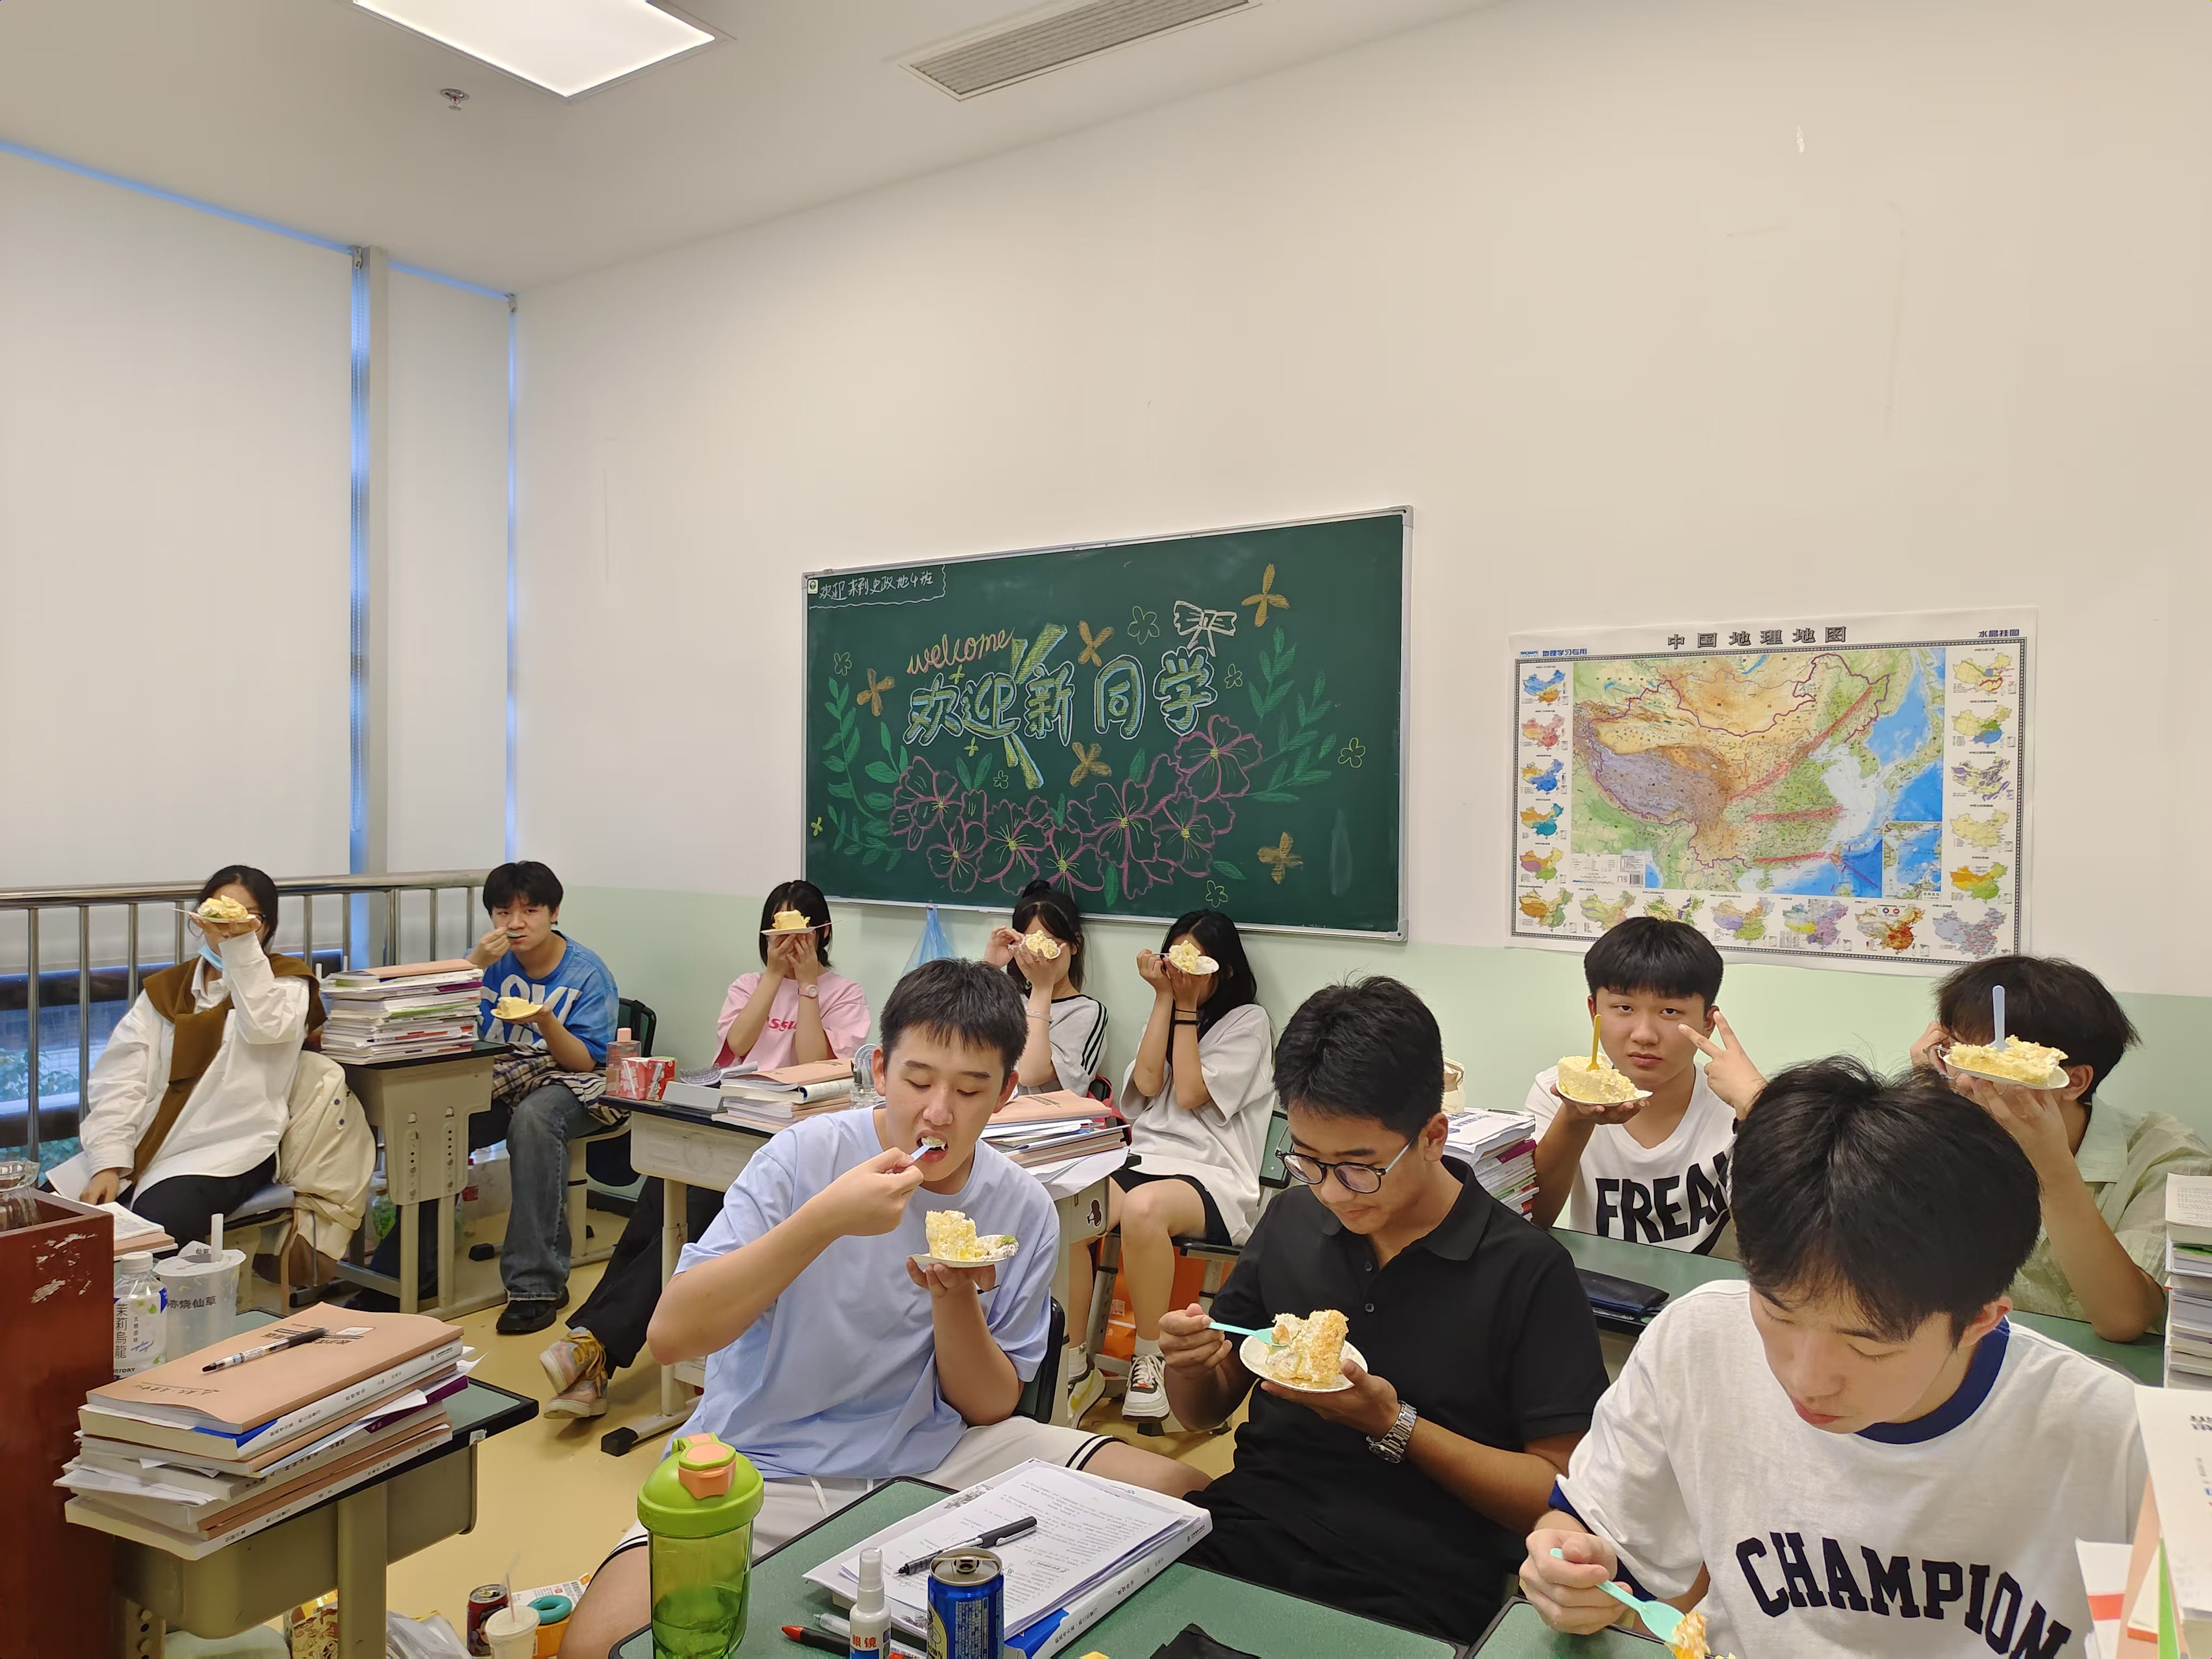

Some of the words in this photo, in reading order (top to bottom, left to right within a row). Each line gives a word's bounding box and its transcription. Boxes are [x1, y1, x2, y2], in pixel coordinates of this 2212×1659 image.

[906, 627, 1015, 674] welcome
[1542, 648, 1587, 657] 地理学习专用
[1668, 626, 1847, 650] 中国地理地图
[902, 647, 1218, 747] 欢迎新同学
[115, 1303, 128, 1359] 茉莉烏龍
[1735, 1531, 2072, 1659] CHAMPION
[852, 1634, 877, 1649] 眼镜
